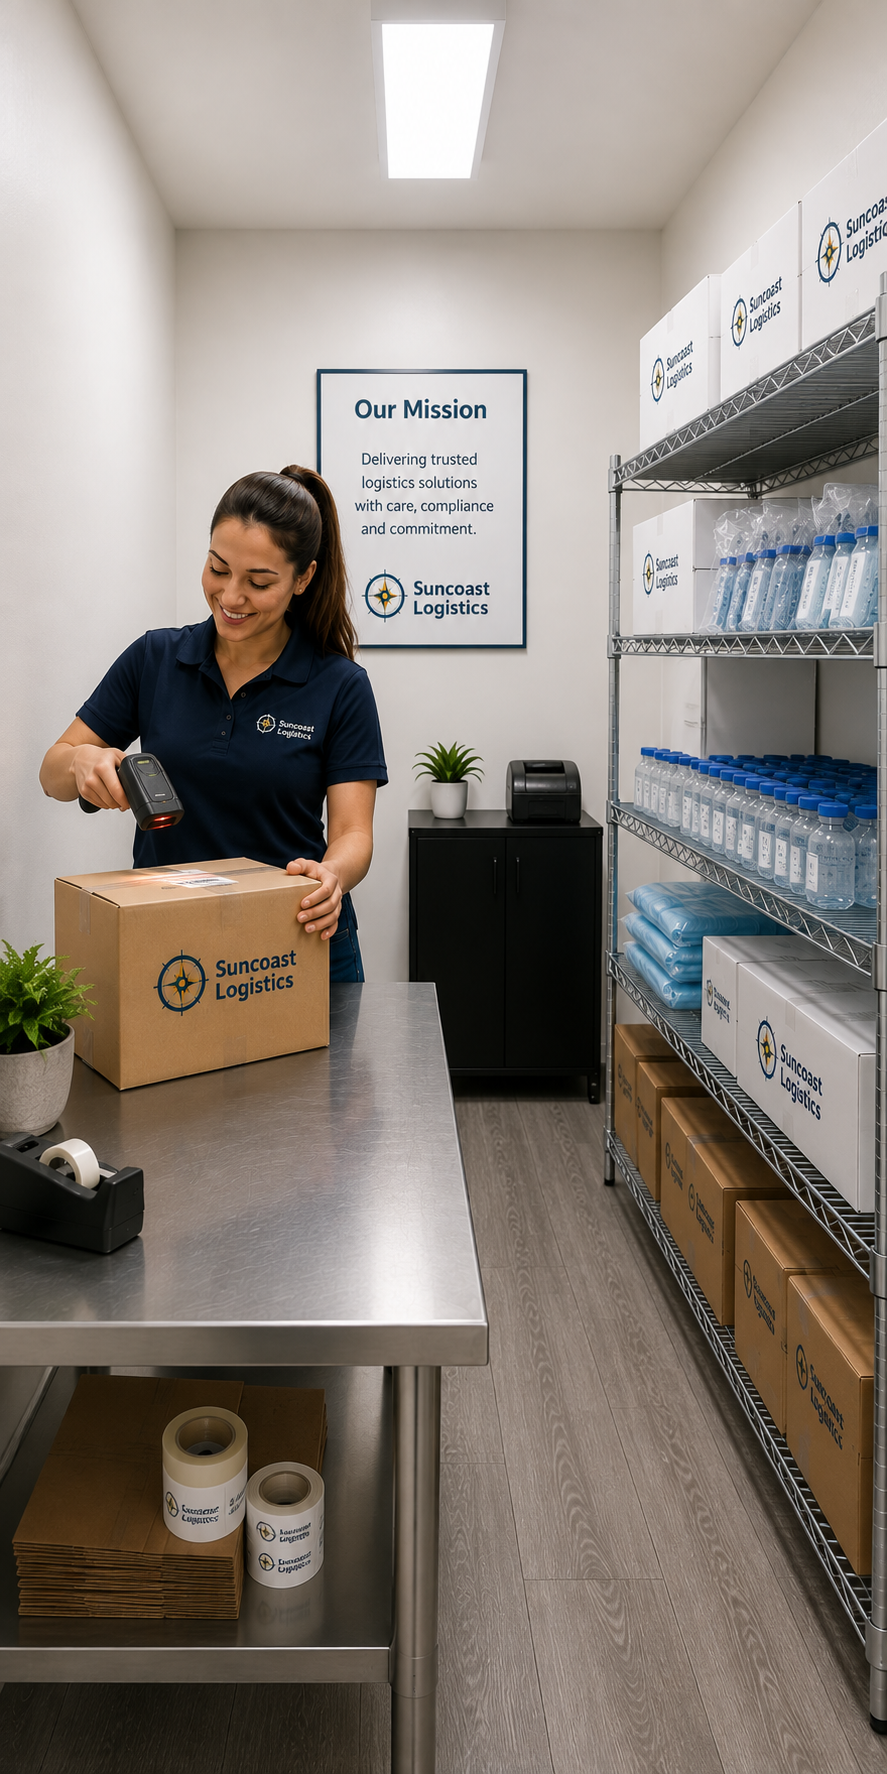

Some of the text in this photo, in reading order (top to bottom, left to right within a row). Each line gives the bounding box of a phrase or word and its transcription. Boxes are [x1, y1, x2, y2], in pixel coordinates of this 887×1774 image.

[846, 196, 887, 238] Suncoas
[846, 219, 887, 263] Logistic
[750, 276, 782, 313] Suncoast
[750, 300, 781, 333] Logistics
[354, 398, 487, 420] Our Mission
[361, 452, 478, 469] Delivering trusted
[361, 476, 478, 492] logistics solutions
[354, 499, 494, 515] with care, compliance
[361, 522, 477, 535] and commitment.
[413, 580, 490, 596] Suncoast
[413, 599, 489, 619] Logistics
[215, 950, 297, 978] Suncoast
[215, 973, 294, 1002] Logistics
[780, 1044, 823, 1096] Suncoast
[780, 1066, 821, 1121] Logistics
